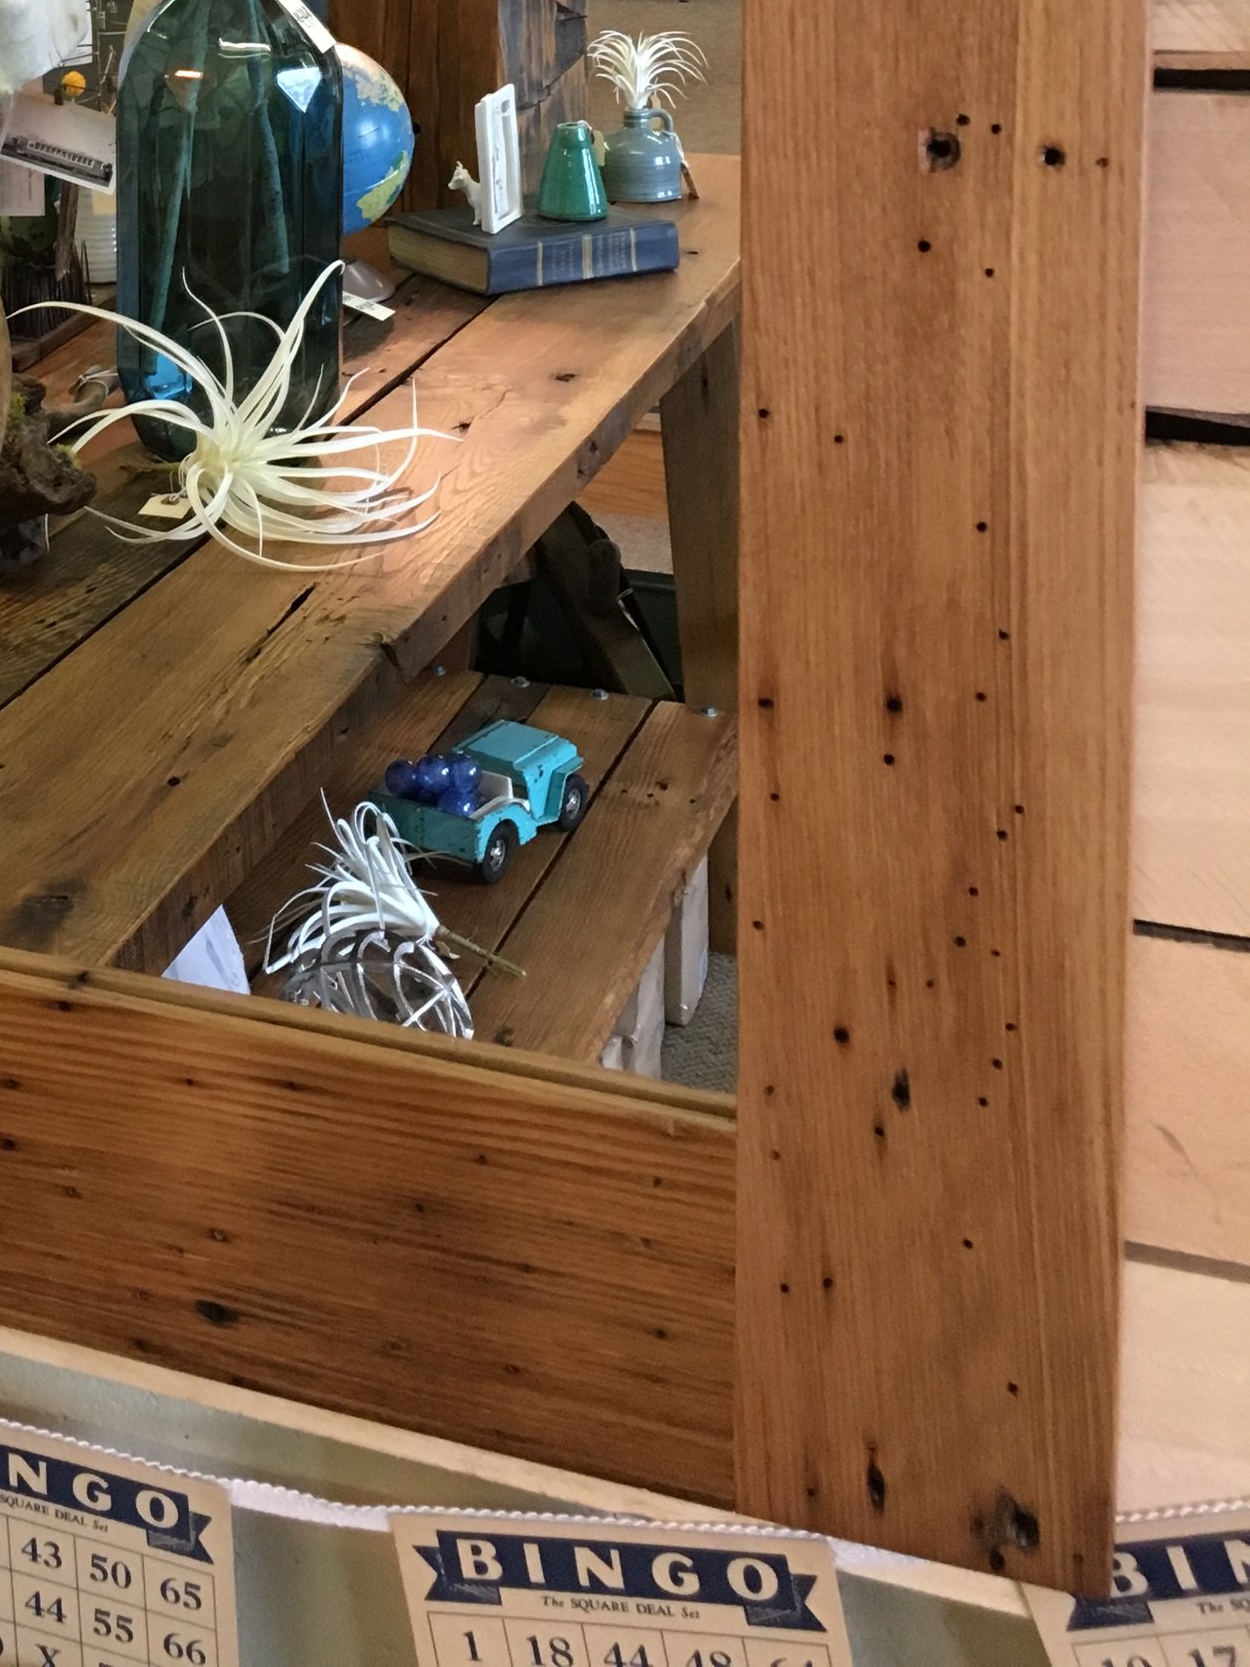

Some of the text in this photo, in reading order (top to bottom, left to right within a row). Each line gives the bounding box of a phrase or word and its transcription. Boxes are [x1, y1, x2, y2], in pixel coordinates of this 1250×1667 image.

[0, 1492, 50, 1516] SQUARE
[54, 1508, 88, 1527] DEAL
[93, 1519, 109, 1533] Set
[21, 1536, 63, 1570] 43
[90, 1553, 132, 1590] 50
[159, 1577, 203, 1611] 65
[455, 1538, 779, 1602] BINGO
[24, 1590, 68, 1624] 44
[93, 1607, 135, 1643] 55
[540, 1595, 701, 1620] The SQUARE DEAL Set
[163, 1632, 207, 1666] 66
[463, 1630, 482, 1663] 1
[526, 1635, 575, 1667] 18
